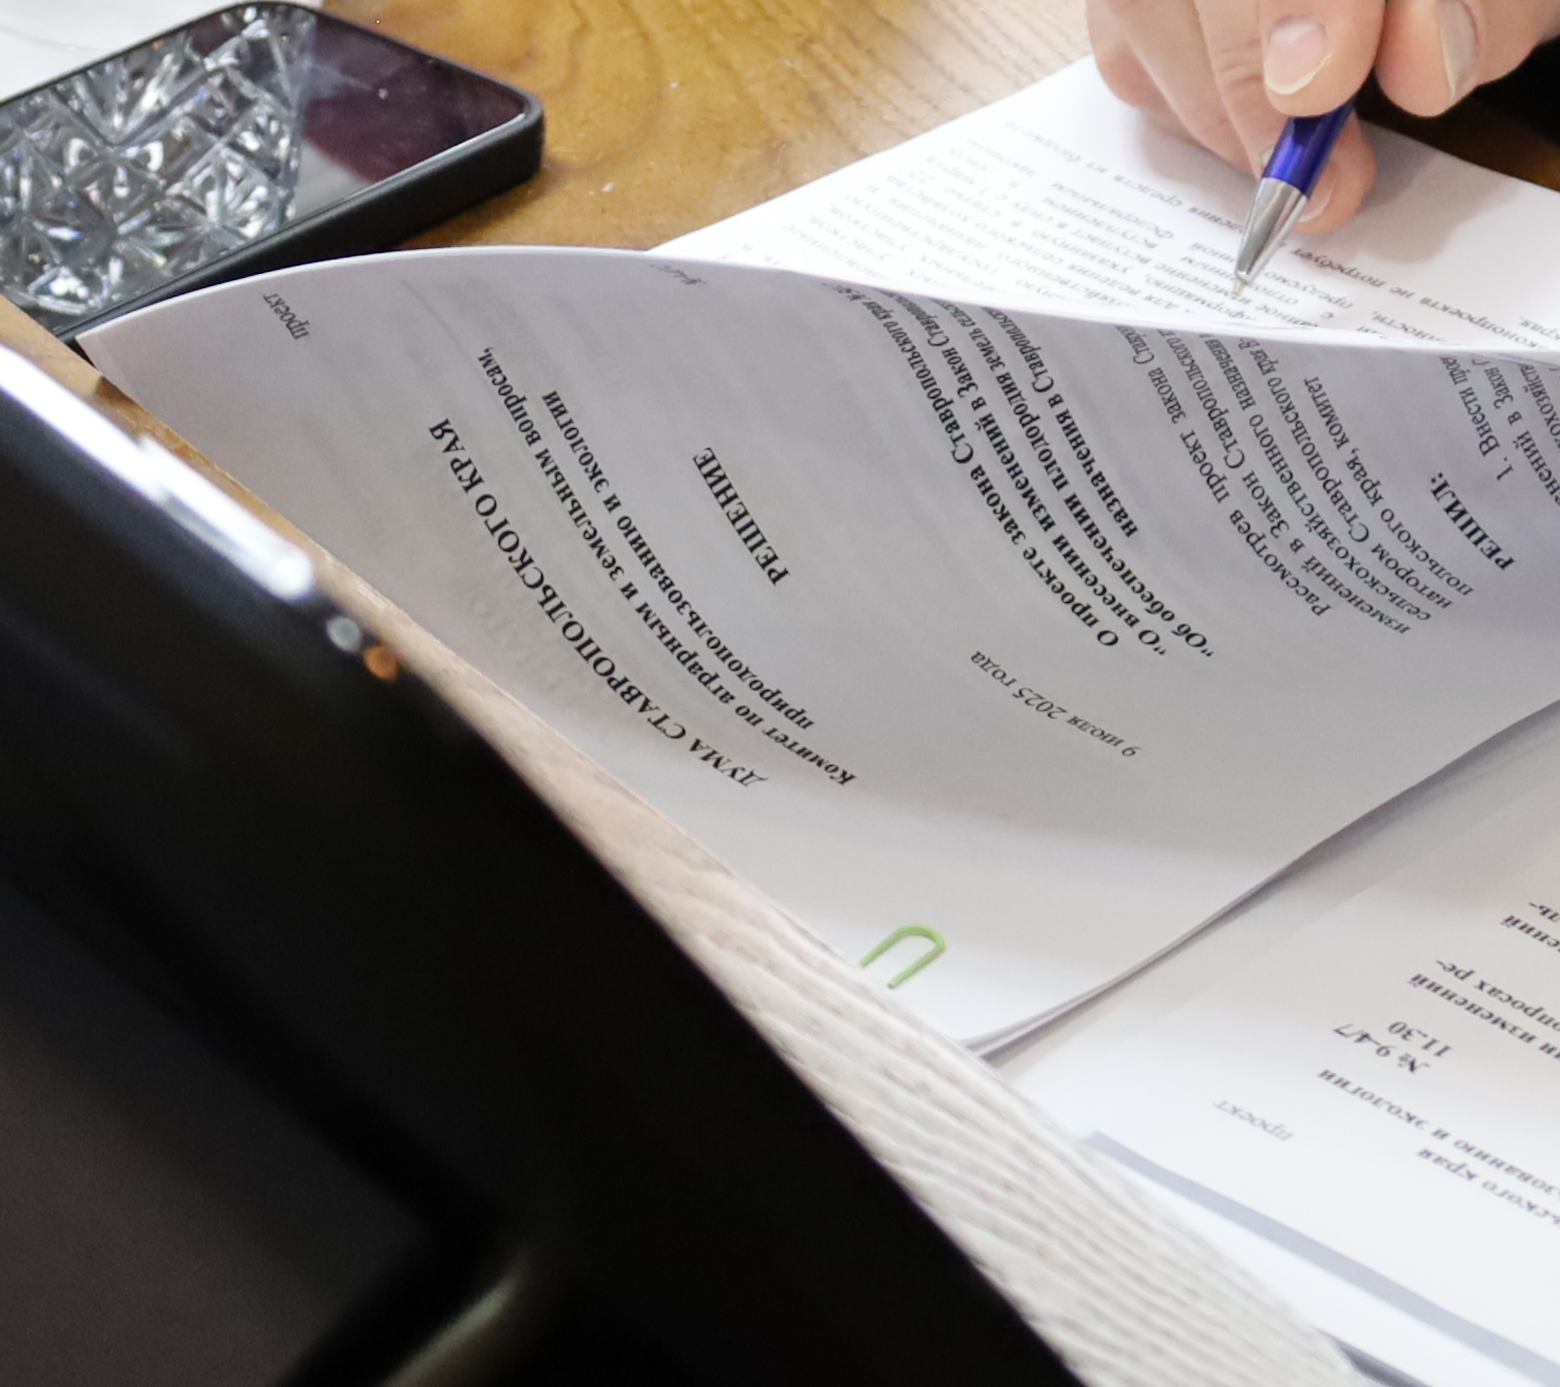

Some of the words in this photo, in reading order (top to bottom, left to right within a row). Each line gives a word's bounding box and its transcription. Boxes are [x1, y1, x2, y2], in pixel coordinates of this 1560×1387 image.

[261, 292, 310, 340] проект
[968, 327, 1005, 372] земель
[477, 347, 542, 447] вопросам,
[881, 316, 974, 464] Ставропольского
[940, 346, 979, 398] Закон
[970, 395, 987, 411] в
[1046, 392, 1064, 409] в
[1147, 366, 1186, 424] закона
[1165, 331, 1245, 469] Ставропольского
[1483, 366, 1514, 409] Закон
[541, 390, 609, 493] экологии
[994, 371, 1069, 492] плодородия
[1302, 376, 1350, 450] комитет
[1458, 385, 1500, 457] Внести
[1506, 410, 1522, 426] в
[428, 417, 484, 494] КРАЯ
[973, 412, 1056, 532] изменений
[1054, 408, 1138, 538] назначения
[1179, 429, 1230, 504] проект
[1266, 376, 1370, 543] Ставропольского
[1344, 447, 1384, 507] края,
[1495, 456, 1513, 481] 1.
[533, 447, 624, 581] земельным
[602, 492, 621, 513] и
[692, 446, 789, 586] РЕШЕНИЕ
[969, 463, 1026, 545] закона
[1241, 469, 1290, 539] Закон
[1248, 413, 1431, 620] сельскохозяйственного
[1430, 471, 1515, 570] РЕШИЛ:
[1051, 533, 1140, 628] внесении
[1062, 492, 1175, 622] обеспечении
[1228, 508, 1331, 616] Рассмотрев
[1288, 537, 1305, 554] в
[1369, 542, 1452, 609] натором
[1379, 507, 1474, 596] польского
[474, 493, 686, 739] СТАВРОПОЛЬСКОГО
[616, 515, 814, 730] природопользованию
[619, 581, 639, 601] и
[1022, 546, 1099, 628] проекте
[1300, 554, 1410, 634] изменений
[634, 601, 735, 704] аграрным
[970, 650, 1017, 687] года
[1096, 629, 1119, 646] О
[734, 704, 764, 727] по
[1011, 687, 1068, 719] 2025
[1066, 714, 1124, 747] июля
[688, 737, 766, 786] ДУМА
[761, 726, 856, 785] Комитет
[1120, 745, 1140, 757] 9
[1332, 1023, 1393, 1057] 9-4/7
[1386, 1020, 1452, 1057] 11.30
[1396, 1052, 1430, 1074] №
